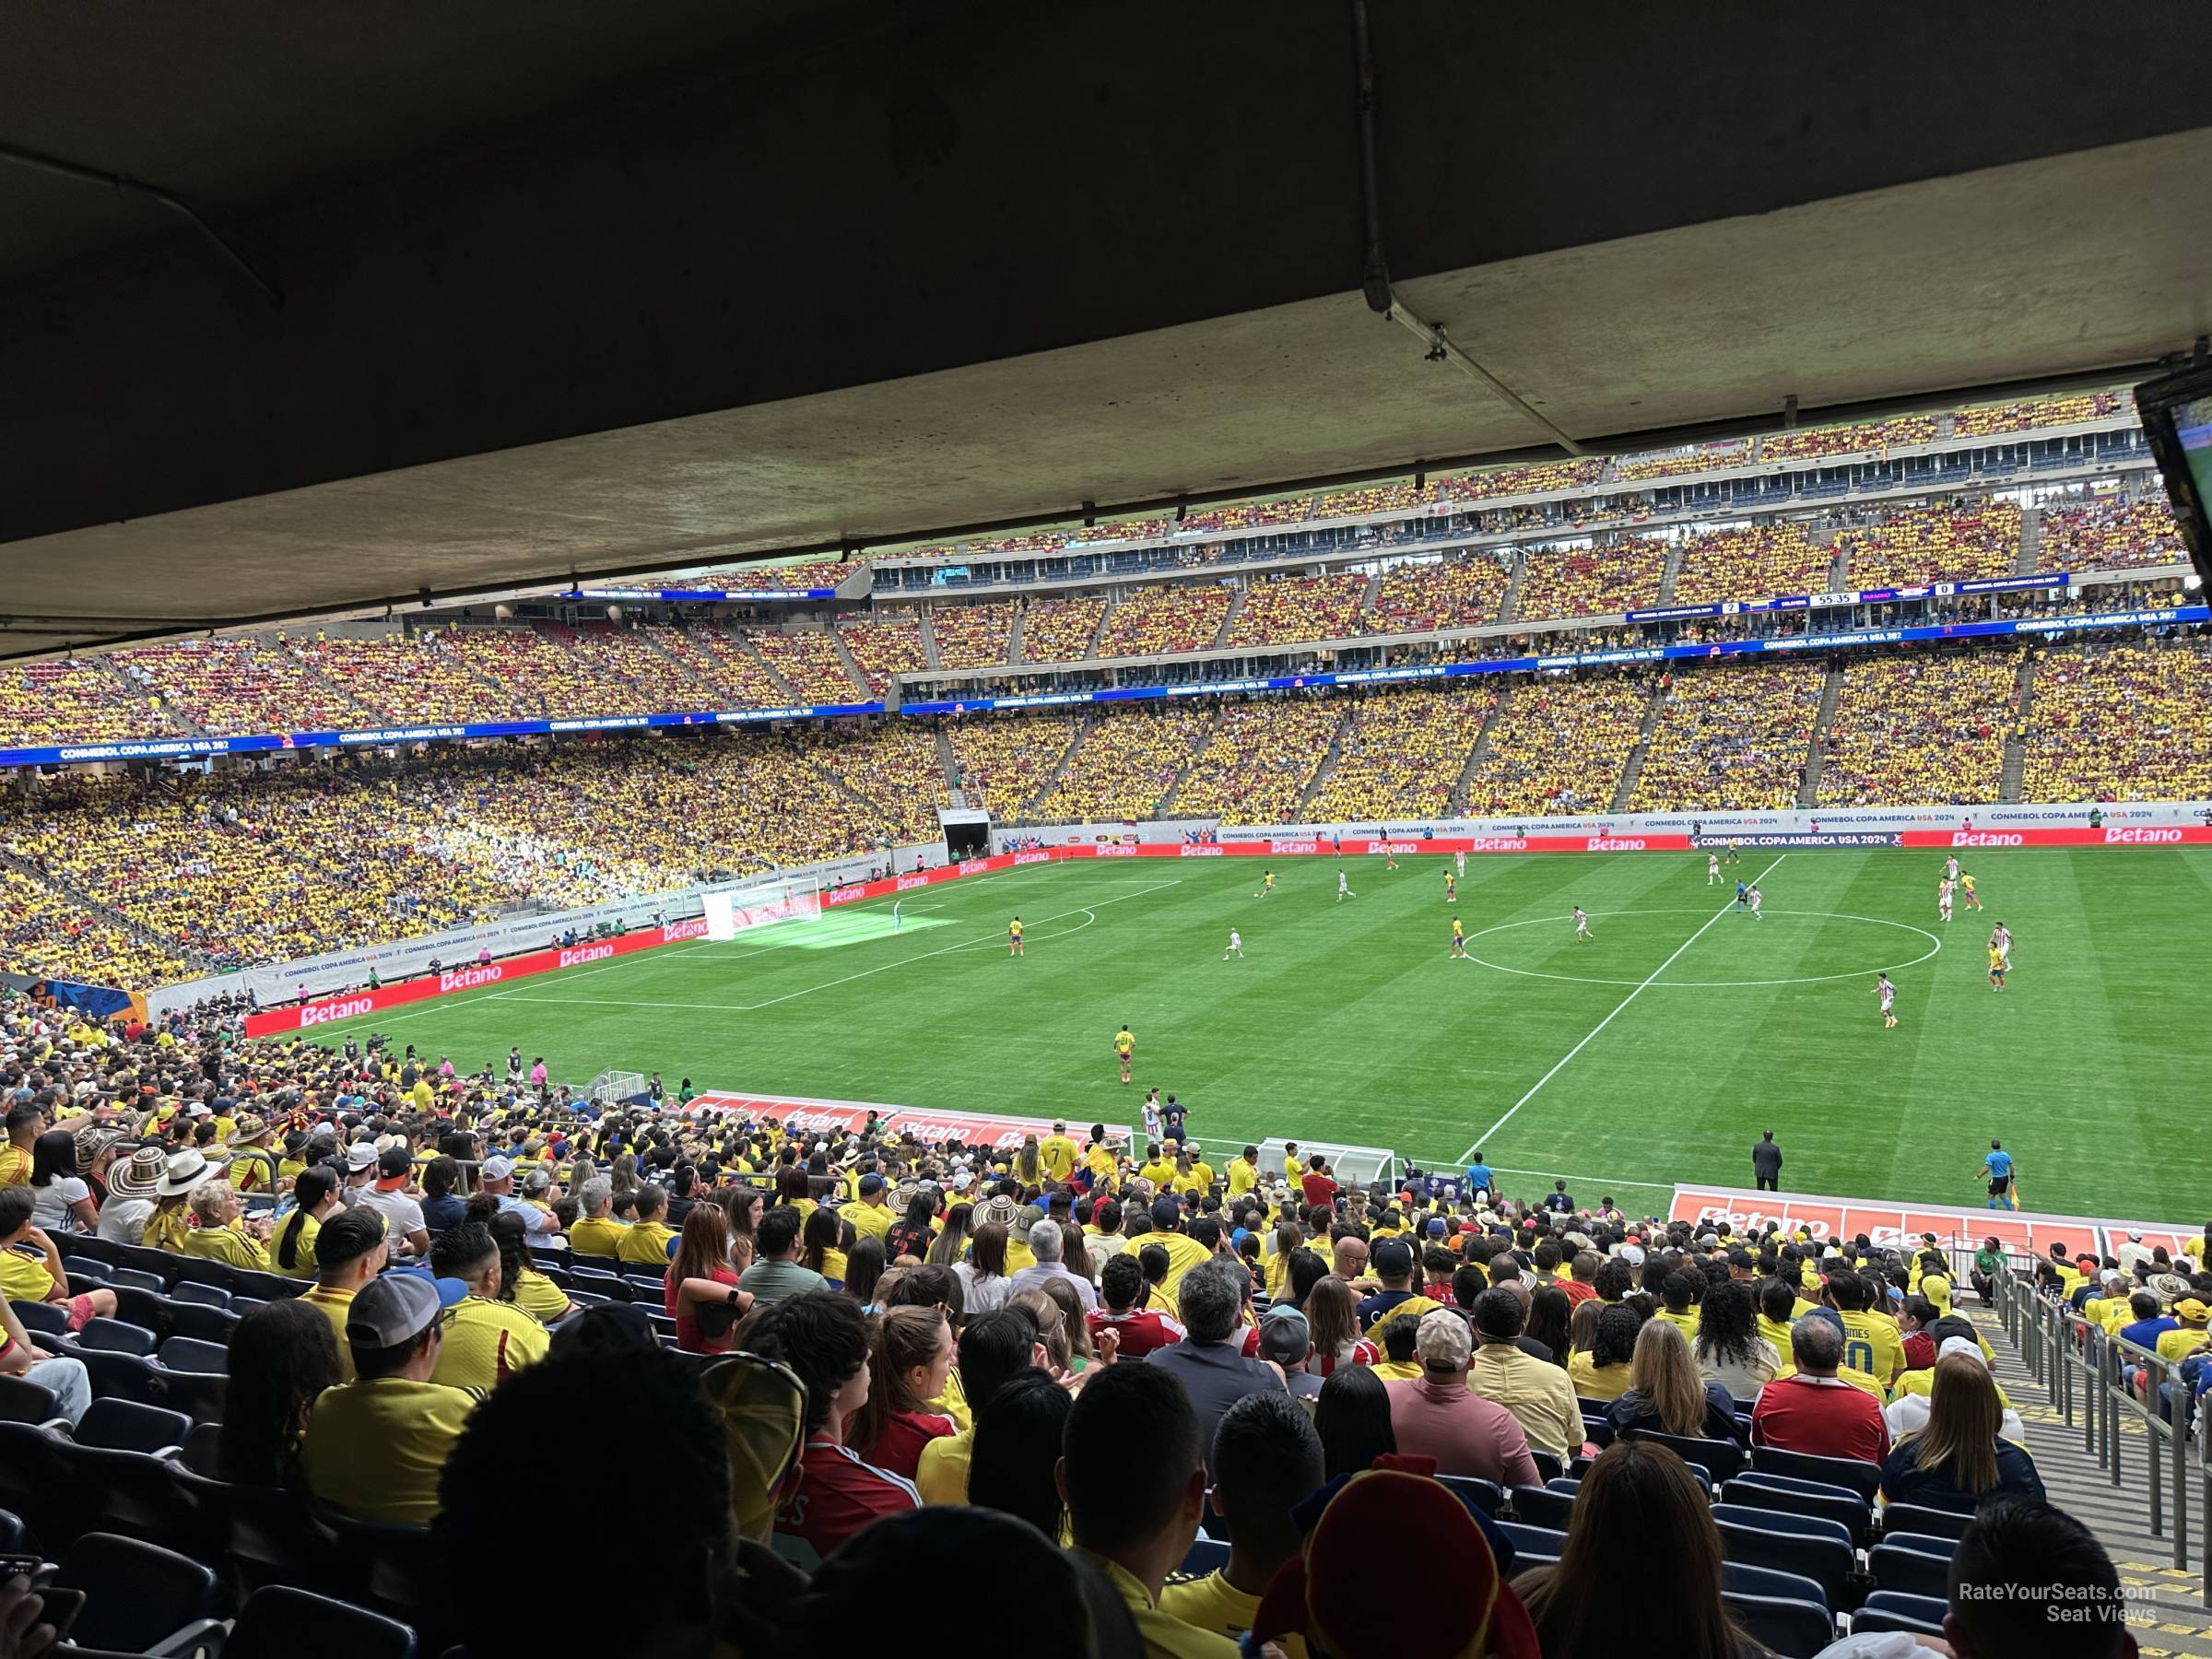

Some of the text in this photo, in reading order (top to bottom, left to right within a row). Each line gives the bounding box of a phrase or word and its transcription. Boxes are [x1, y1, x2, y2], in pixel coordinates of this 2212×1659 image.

[1819, 594, 1850, 606] 55:35
[1728, 604, 1734, 612] 2
[1991, 812, 2040, 820] CONMEBOL
[1759, 836, 1787, 845] COPA
[1788, 836, 1836, 845] AMERICA
[1839, 836, 1859, 844] USA
[1861, 835, 1887, 844] 2024
[1951, 832, 2023, 846] Betano
[2105, 828, 2183, 841] Betano
[1097, 844, 1135, 855] Betano
[1181, 844, 1224, 855] Betano
[1271, 841, 1316, 853] Betano
[1474, 839, 1526, 851] Betano
[1587, 839, 1645, 851] Betano
[1015, 851, 1050, 865] Betano
[959, 861, 987, 875] Betano
[897, 875, 928, 890] Betano
[830, 887, 865, 902] Betano
[437, 939, 451, 948] COPA
[452, 935, 475, 946] AMERICA
[560, 944, 613, 967] Betano
[322, 962, 337, 971] COPA
[339, 957, 365, 968] AMERICA
[367, 954, 377, 963] USA
[441, 966, 501, 991] Betano
[300, 998, 371, 1027] Betano
[783, 1110, 853, 1128] Betano
[1147, 1111, 1152, 1121] 8
[1051, 1148, 1059, 1165] 7
